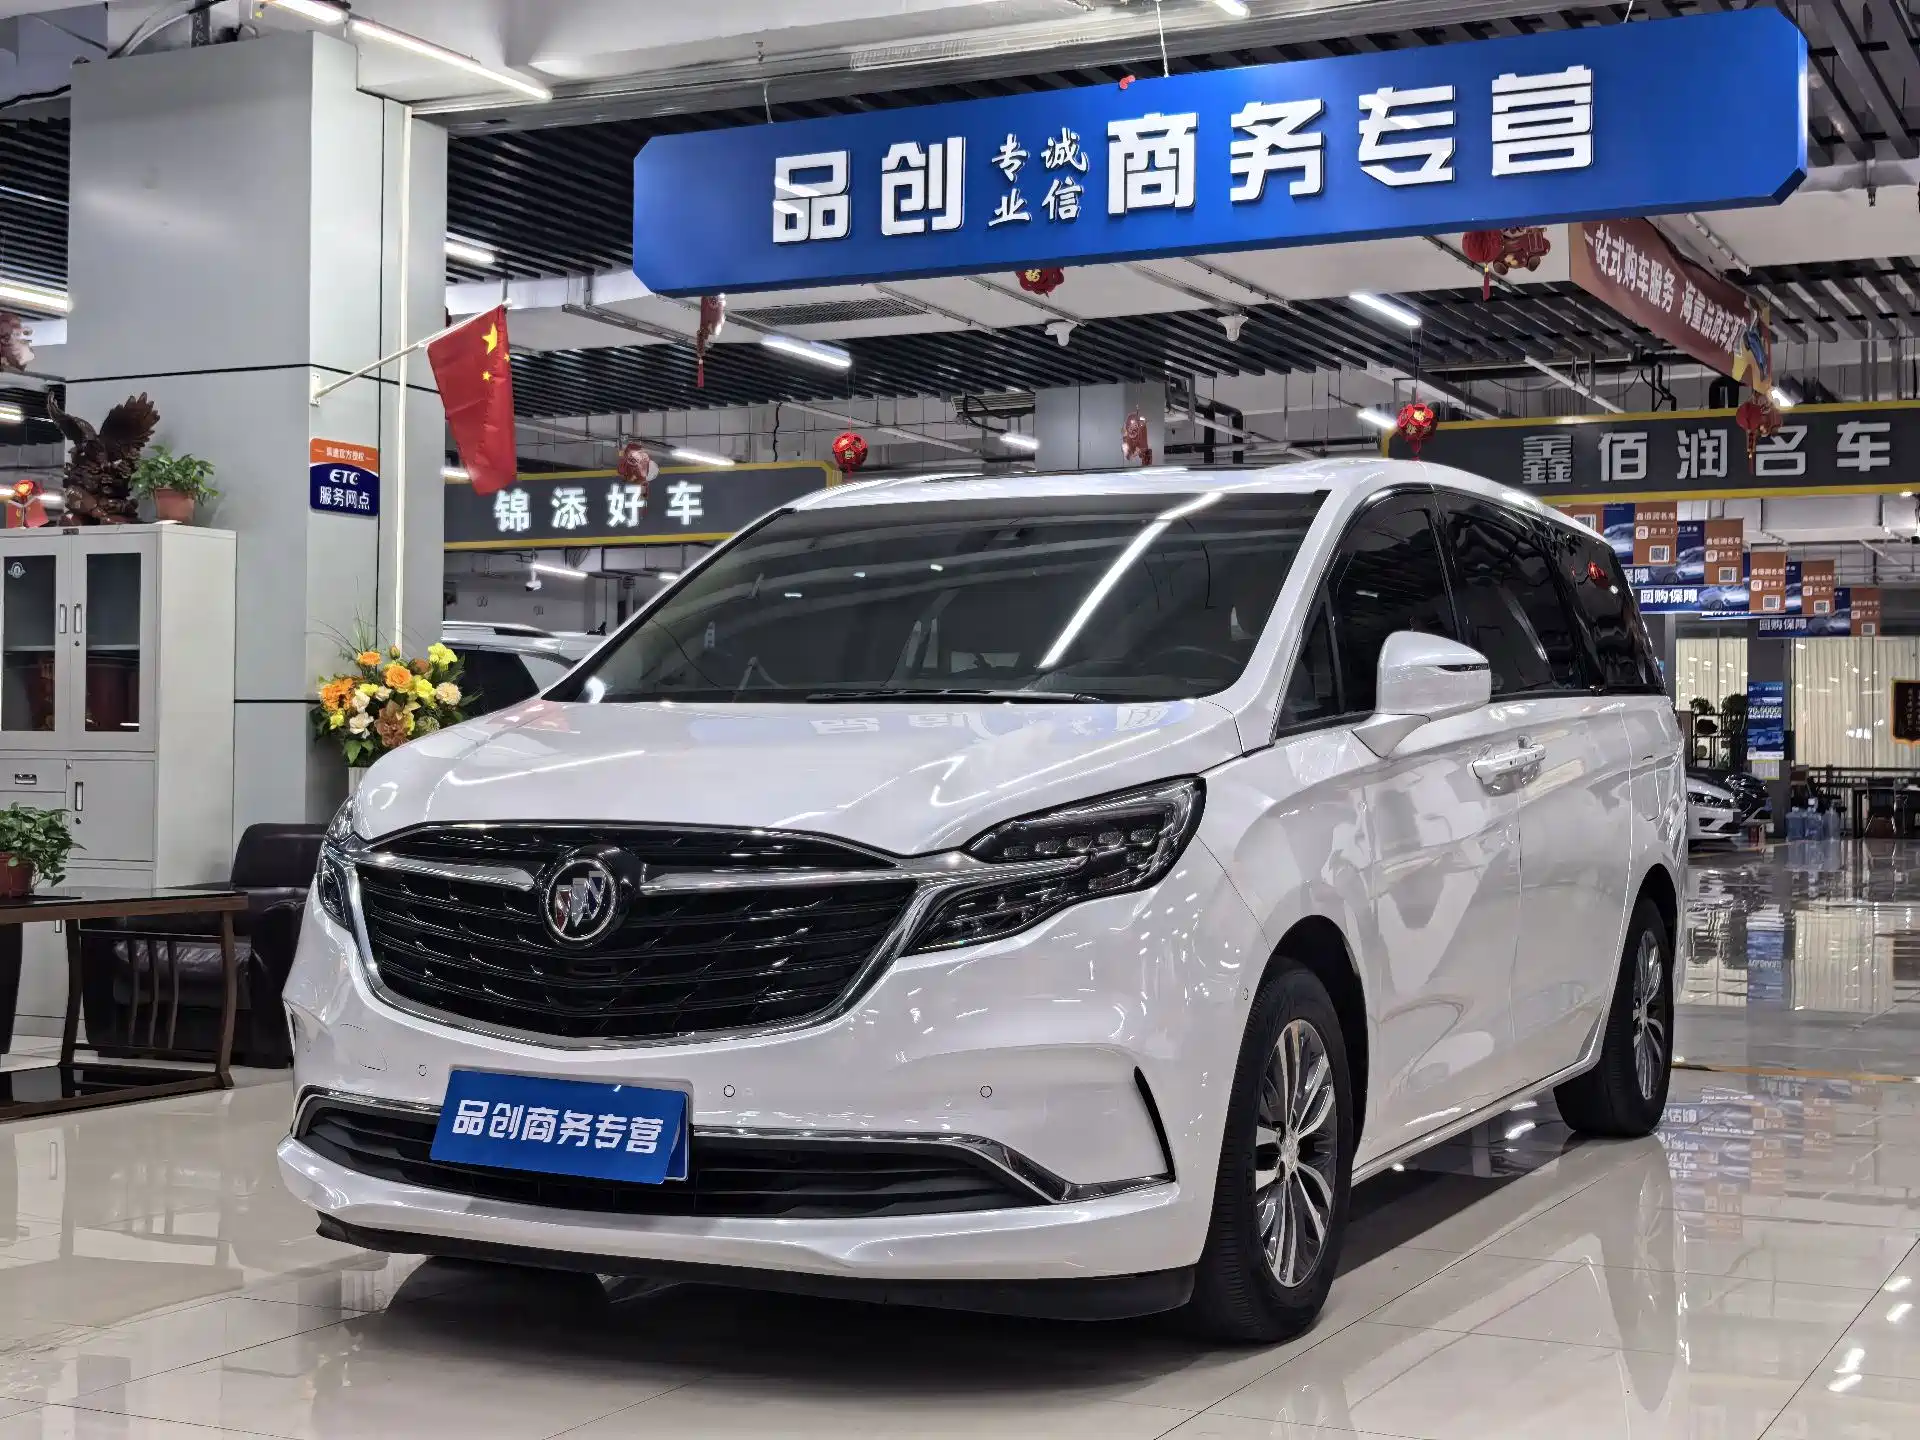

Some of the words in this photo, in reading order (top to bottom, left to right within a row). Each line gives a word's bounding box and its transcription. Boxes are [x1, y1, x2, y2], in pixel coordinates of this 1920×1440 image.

[772, 136, 966, 244] 品创
[1107, 65, 1593, 215] 商务专营
[1584, 223, 1676, 313] 一站式购车服务
[329, 468, 361, 485] ETC
[1521, 420, 1891, 485] 鑫佰润名车
[319, 485, 371, 511] 服务网点
[493, 480, 704, 533] 锦添好车
[1640, 588, 1698, 605] 回购保障
[451, 1099, 664, 1155] 品创商务专营
